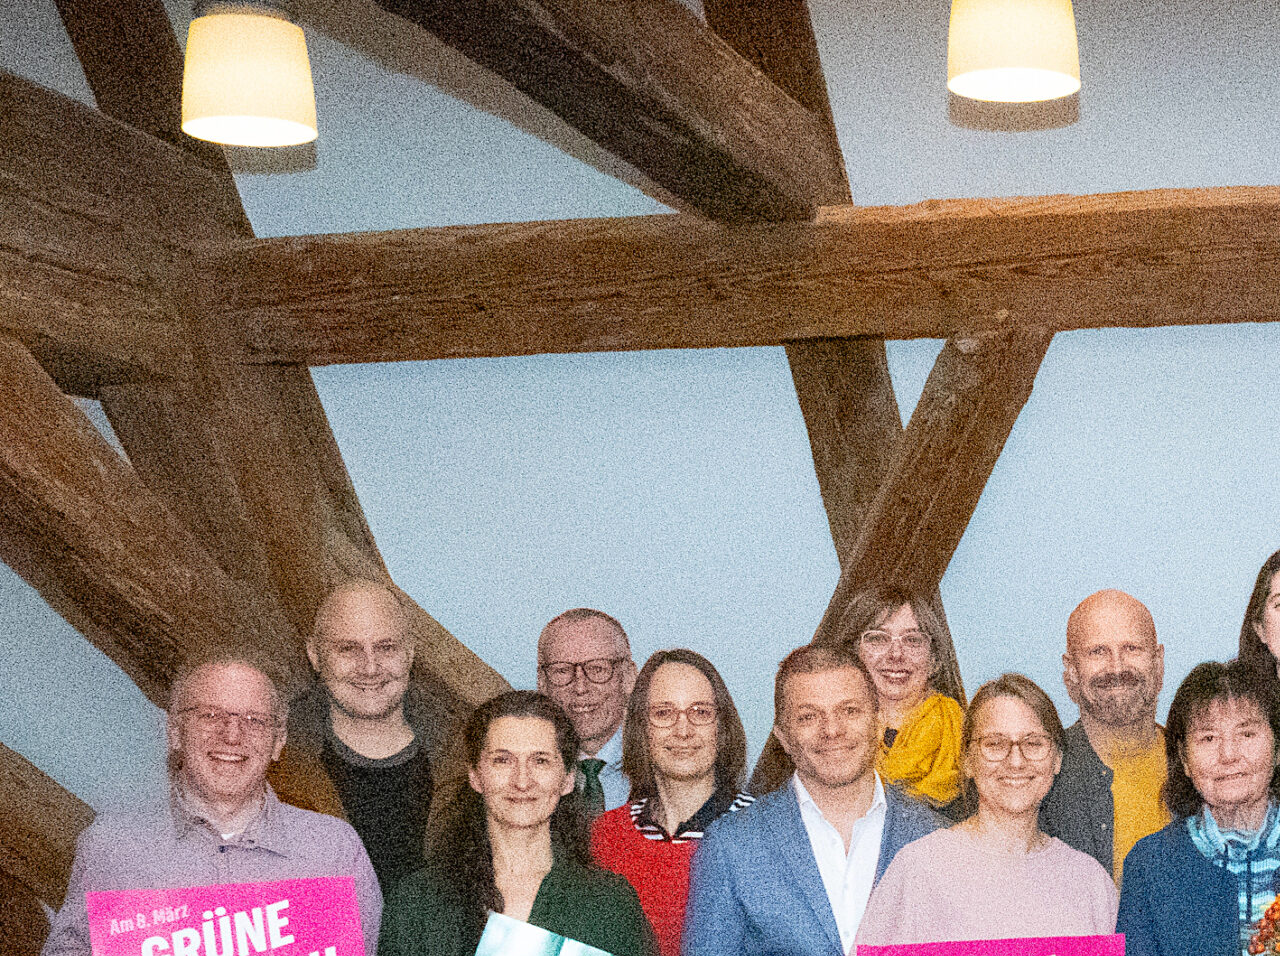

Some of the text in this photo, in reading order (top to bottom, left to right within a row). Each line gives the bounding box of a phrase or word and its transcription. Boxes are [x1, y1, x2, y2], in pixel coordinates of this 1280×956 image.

[110, 904, 189, 936] Am 8. März
